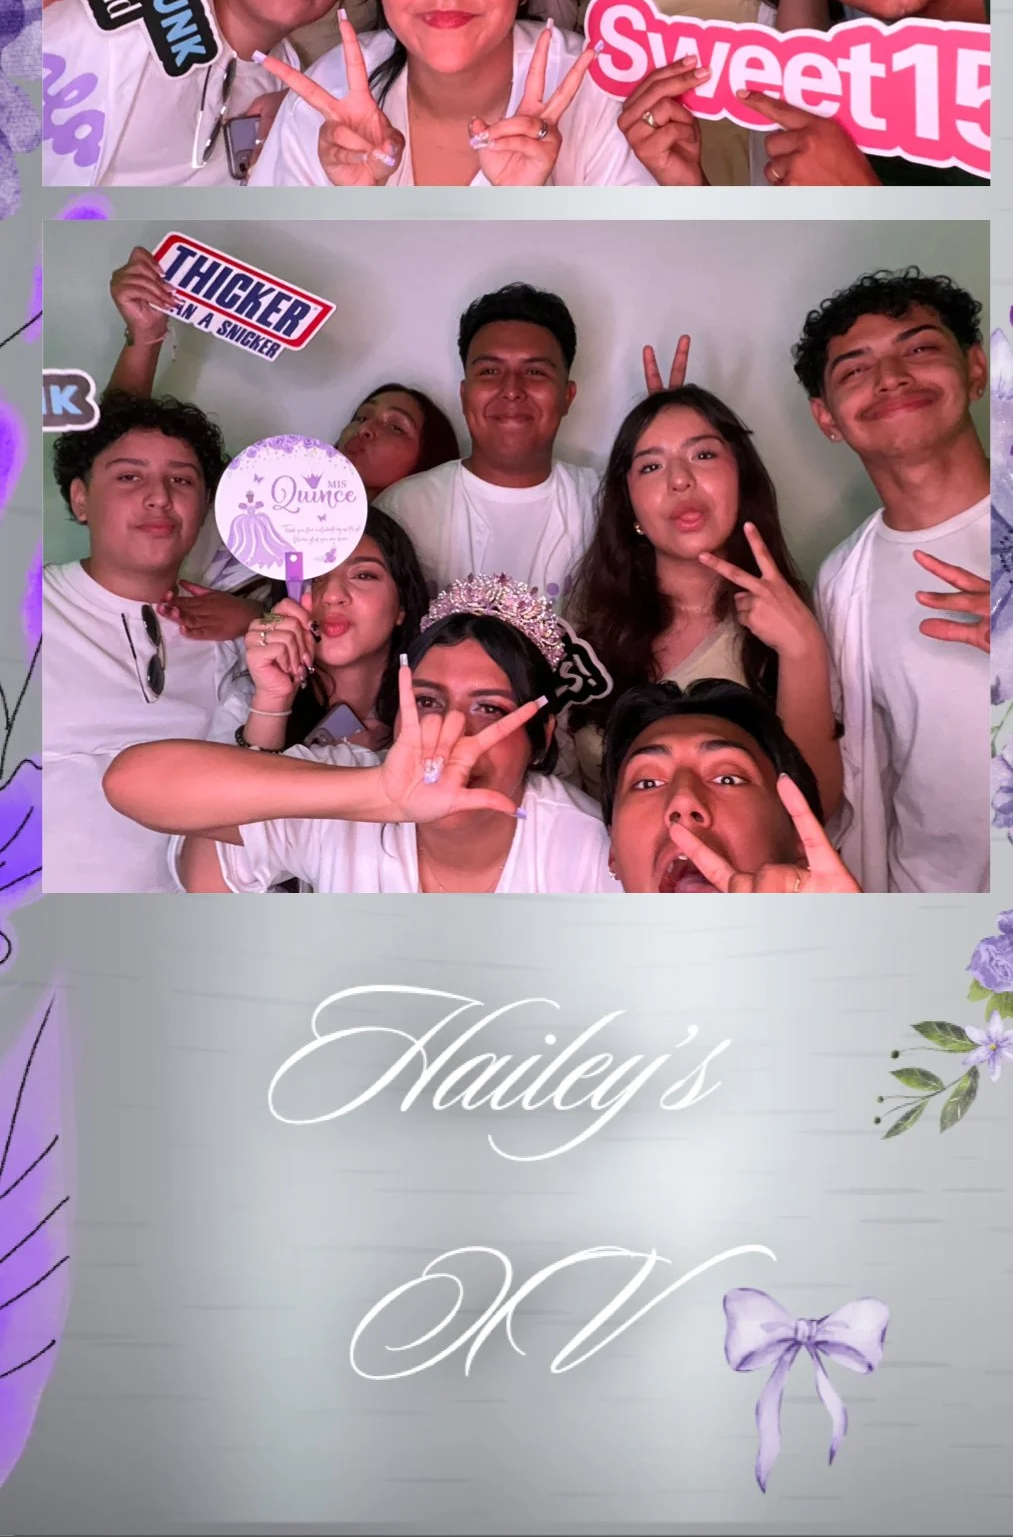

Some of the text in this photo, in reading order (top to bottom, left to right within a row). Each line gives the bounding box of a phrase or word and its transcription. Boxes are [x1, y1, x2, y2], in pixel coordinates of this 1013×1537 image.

[163, 244, 312, 338] THICKER
[198, 312, 215, 329] A
[216, 319, 282, 359] SNICKER
[271, 474, 357, 514] Quince
[327, 479, 348, 489] MIS
